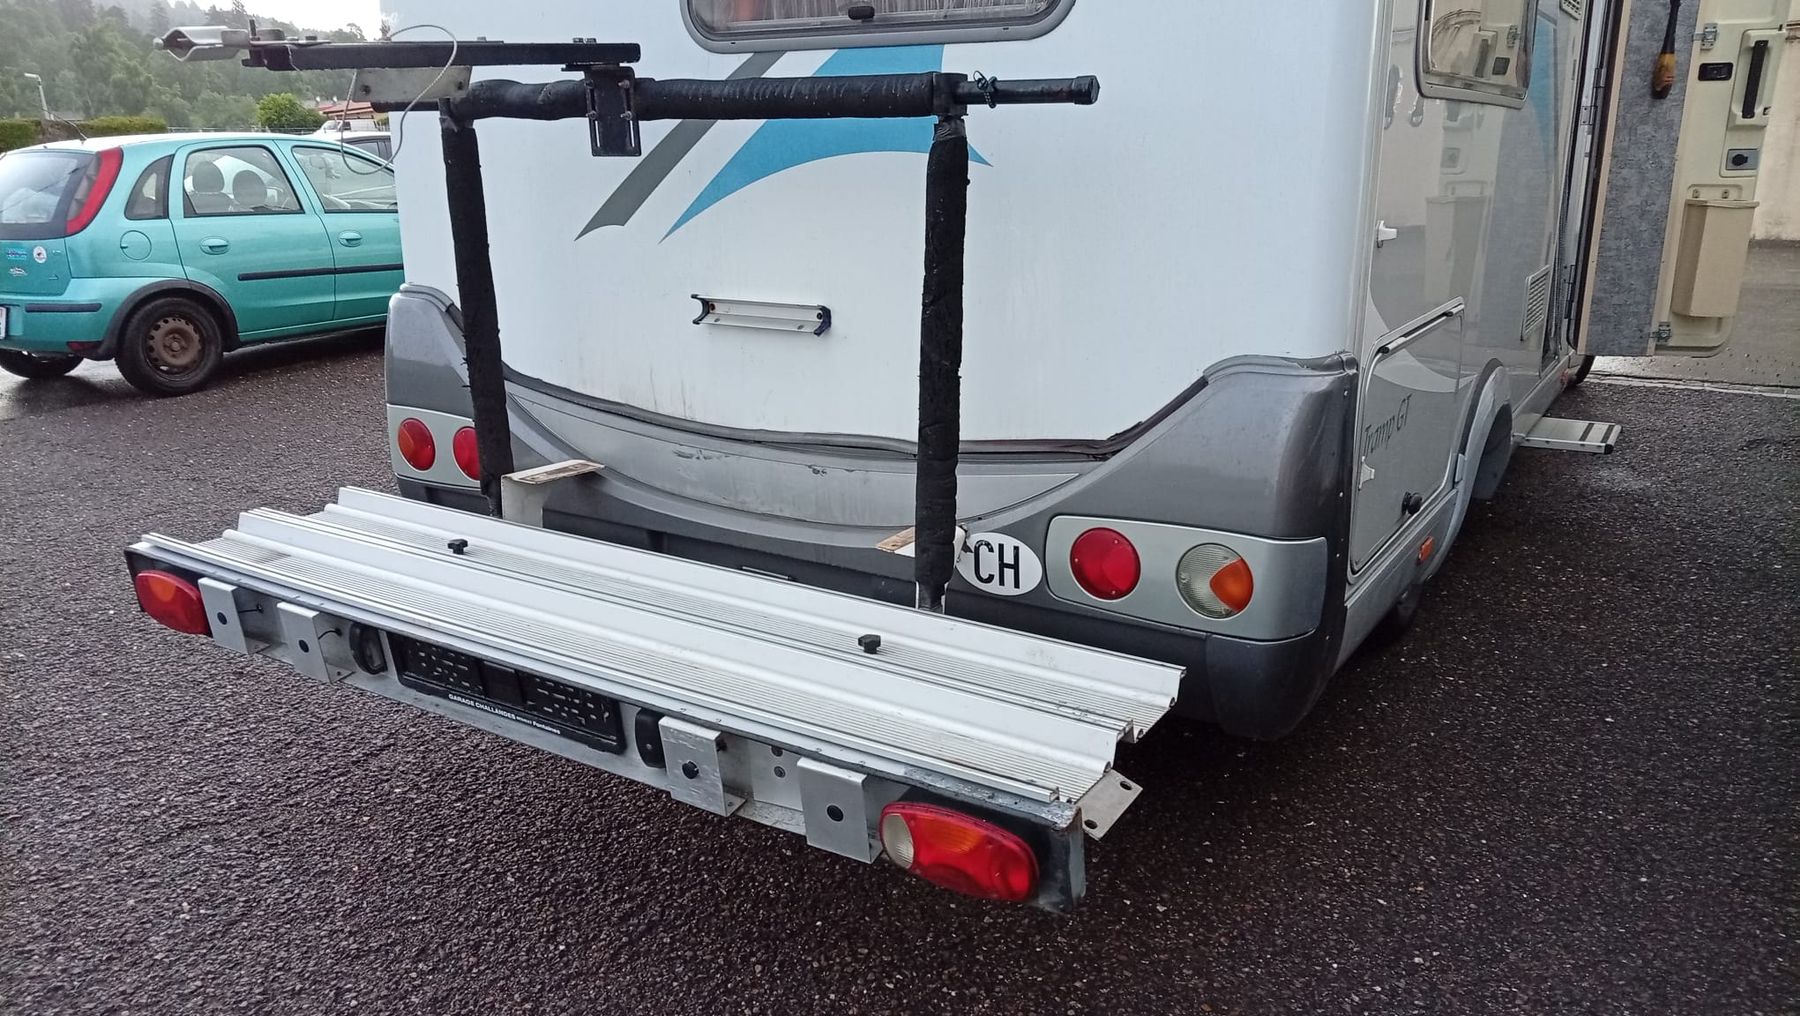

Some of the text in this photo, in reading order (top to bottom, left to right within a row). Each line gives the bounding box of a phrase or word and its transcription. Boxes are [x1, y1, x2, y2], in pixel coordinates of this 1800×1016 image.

[1363, 393, 1413, 458] Tramp GT
[974, 539, 1020, 589] CH
[448, 693, 475, 706] GARAGE
[475, 702, 516, 720] CHALLANDES
